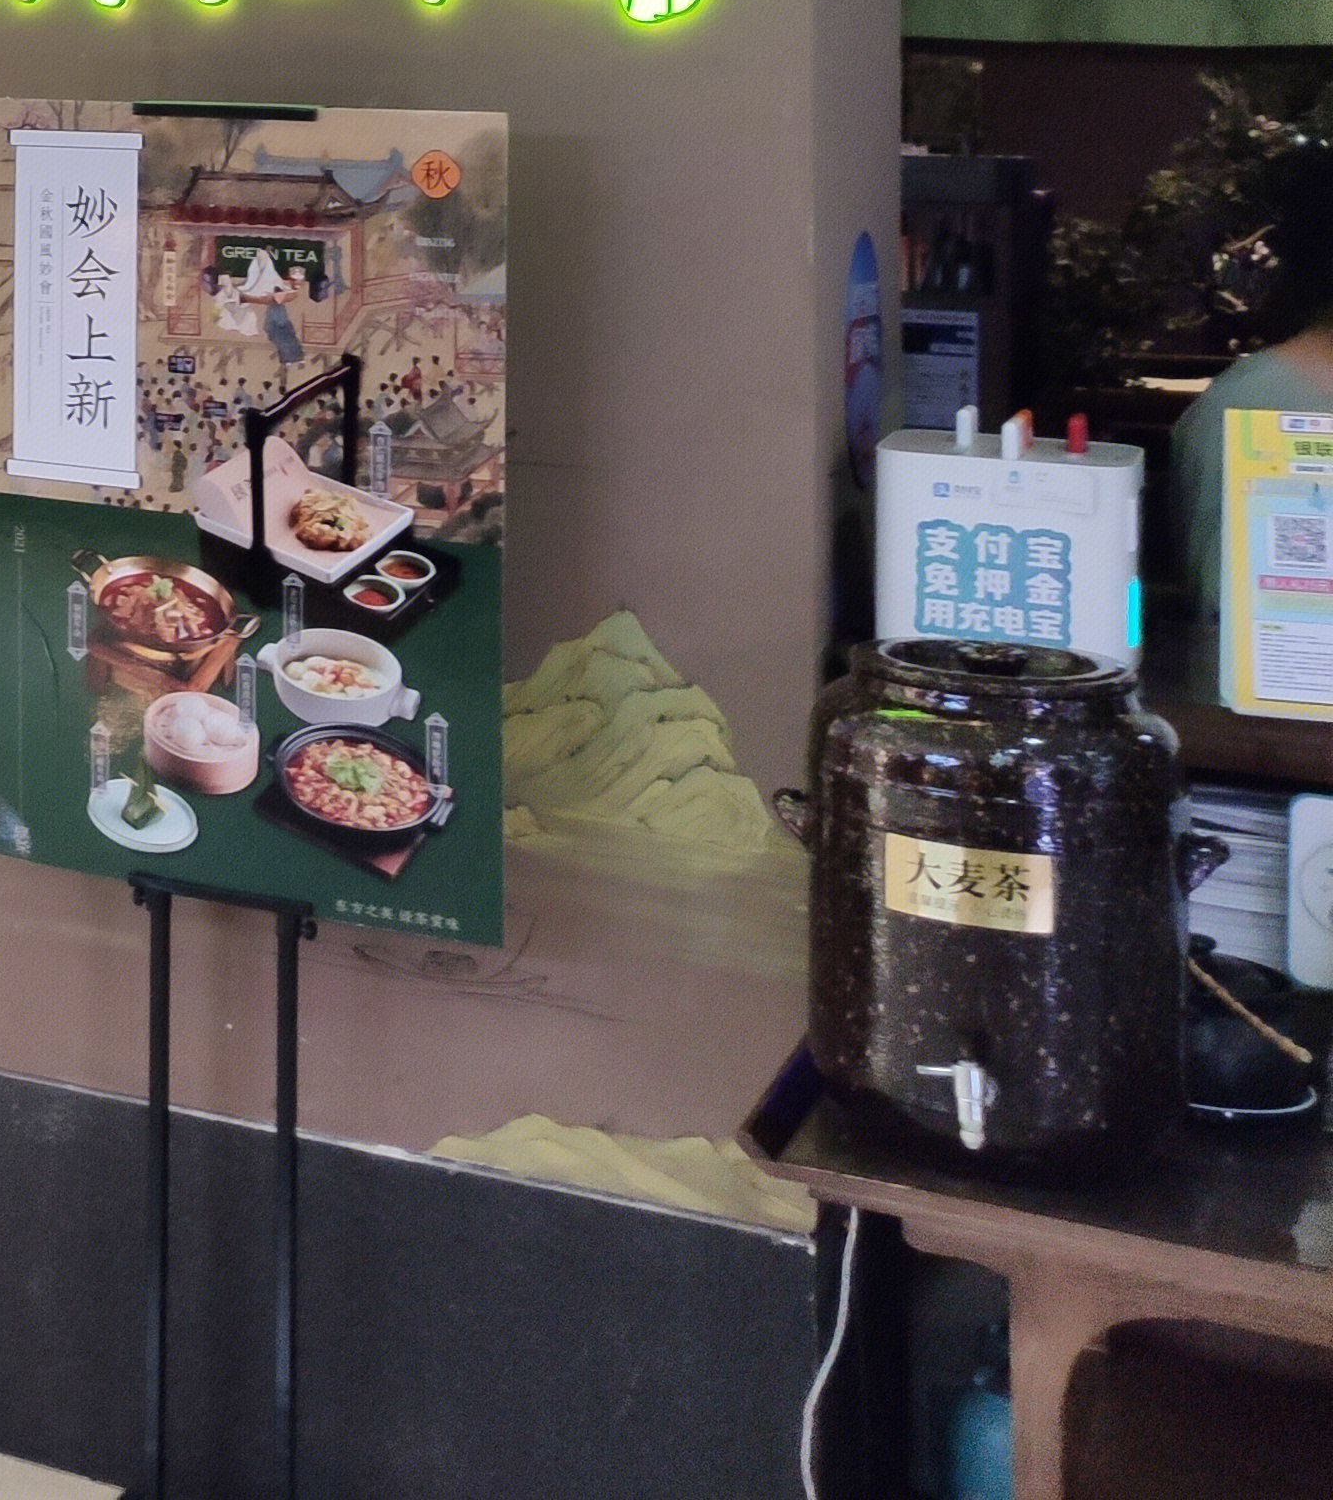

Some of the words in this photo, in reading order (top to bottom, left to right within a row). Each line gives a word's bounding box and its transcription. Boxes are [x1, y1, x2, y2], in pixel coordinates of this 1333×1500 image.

[419, 159, 452, 191] 秋
[221, 245, 280, 261] GREN
[282, 248, 318, 263] TEA
[64, 184, 121, 430] 妙会上新
[924, 526, 1064, 570] 支付宝
[924, 562, 1064, 606] 免押金
[922, 597, 1064, 641] 用充电宝
[905, 851, 1031, 902] 大麦茶
